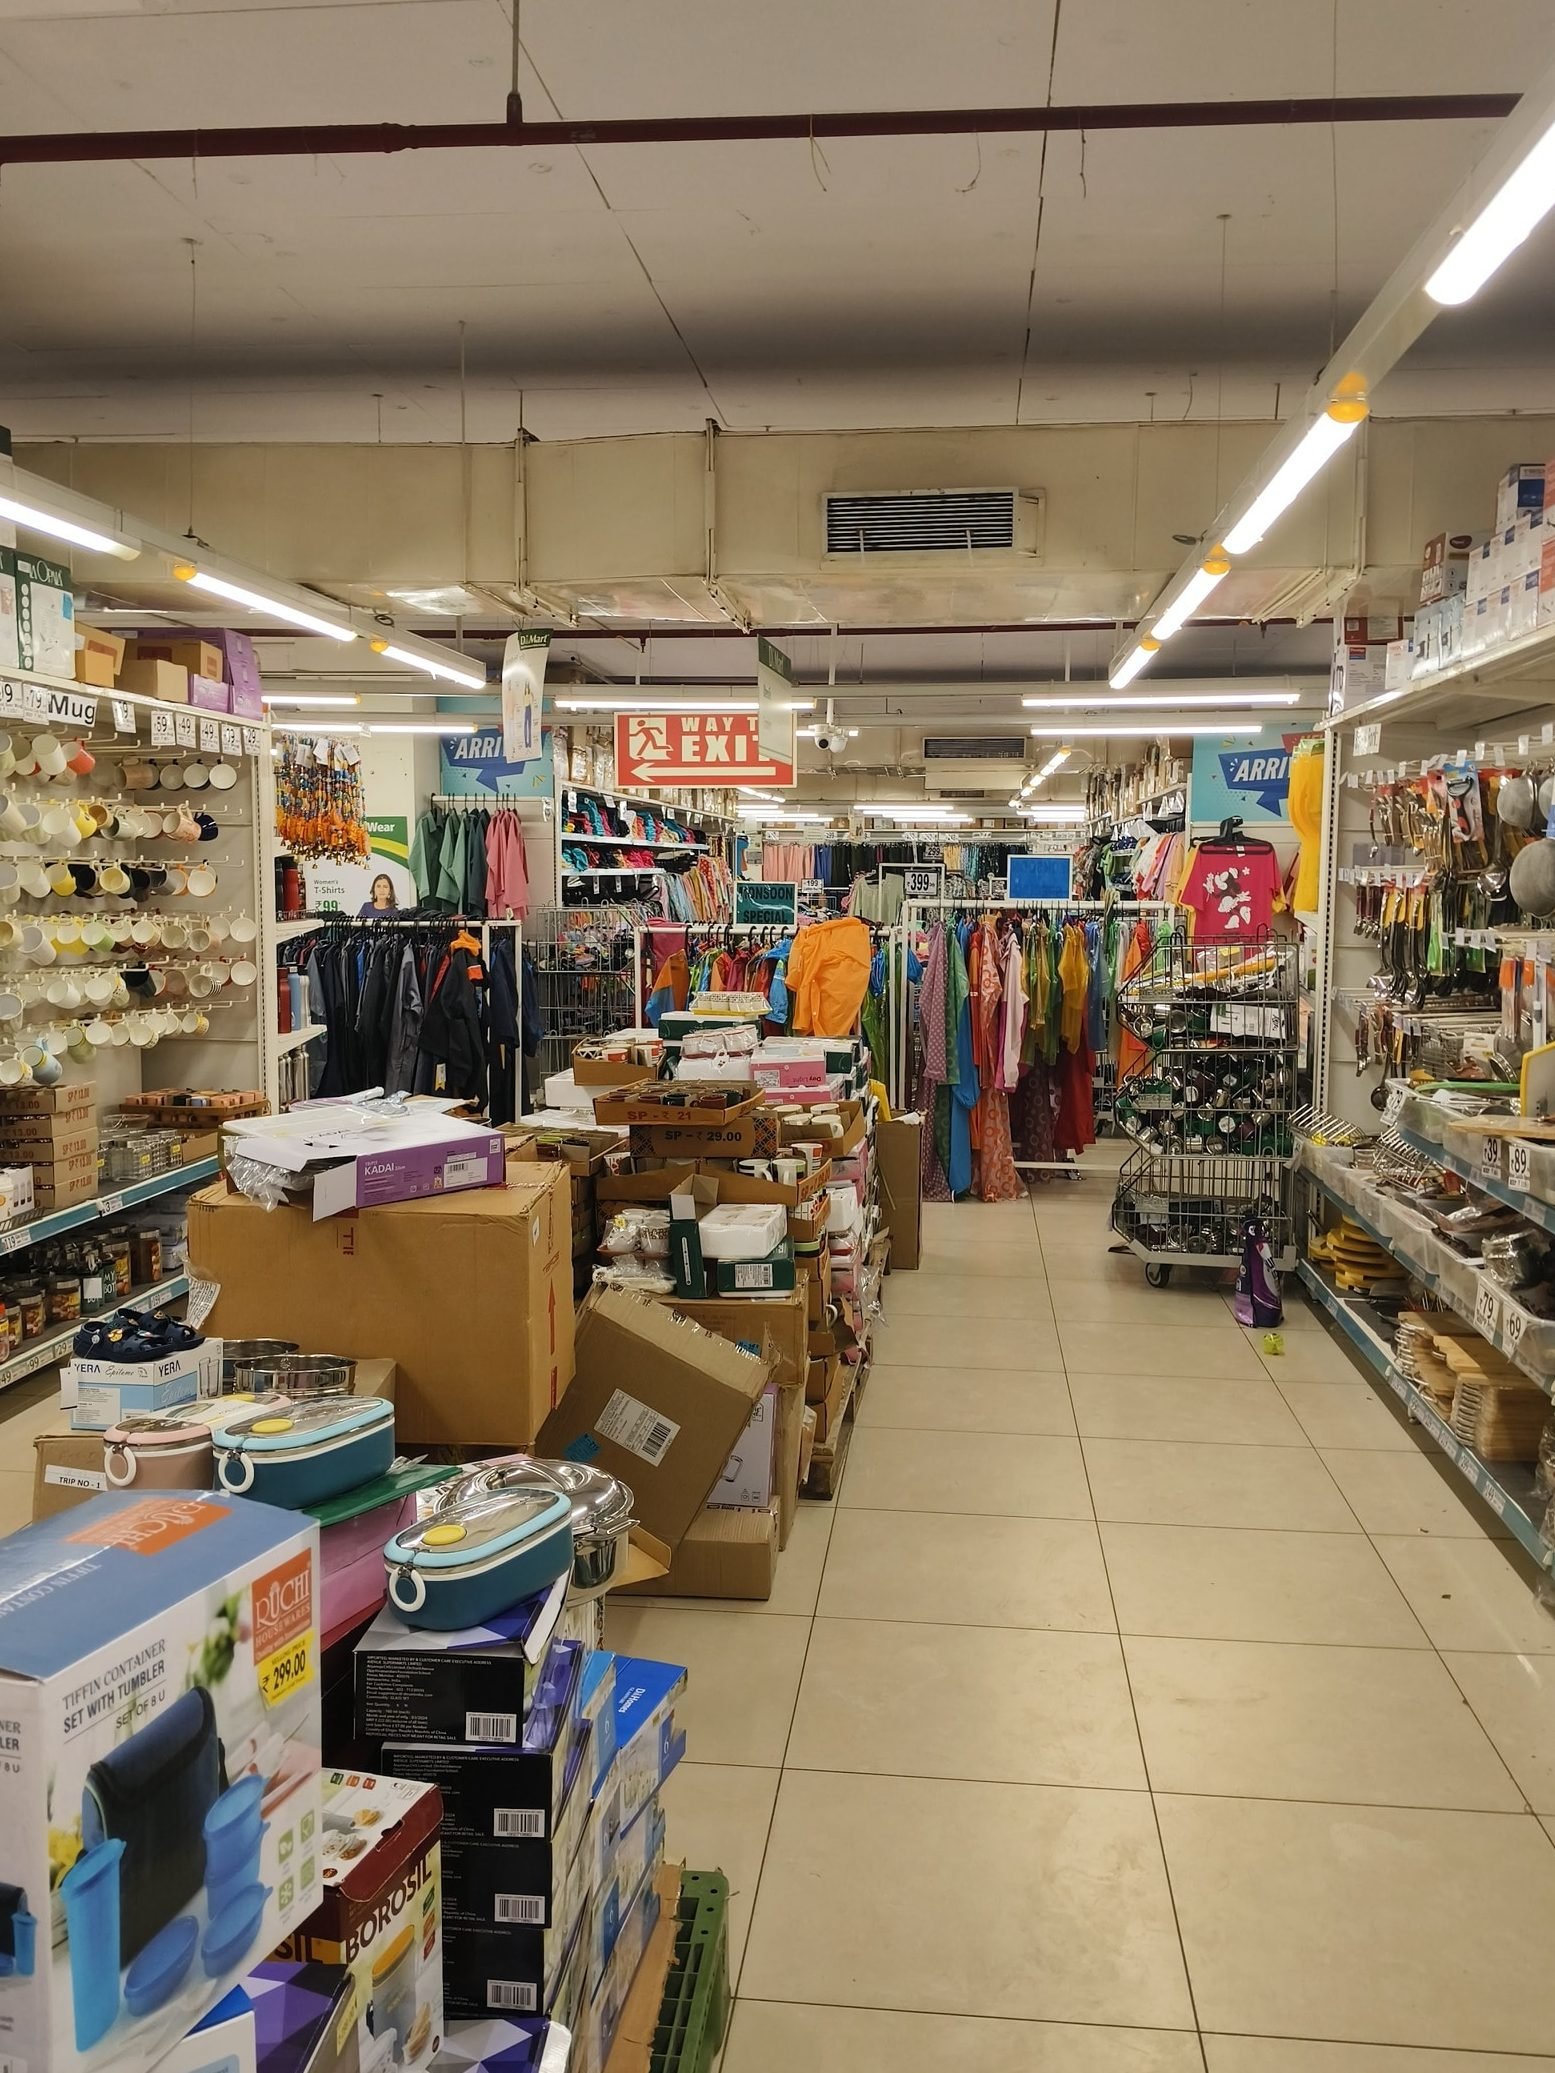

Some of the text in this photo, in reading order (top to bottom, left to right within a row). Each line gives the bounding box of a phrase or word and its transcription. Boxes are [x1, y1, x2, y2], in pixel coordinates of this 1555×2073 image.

[48, 694, 95, 725] Mug
[681, 717, 759, 732] WAY T
[454, 736, 502, 759] ARRI
[1233, 756, 1294, 782] ARRI
[367, 822, 395, 832] Wear
[314, 886, 345, 894] T-Shirts
[743, 910, 788, 922] SPECIAL
[627, 1110, 647, 1120] SP
[677, 1111, 691, 1120] 21
[665, 1130, 682, 1141] SP
[706, 1131, 742, 1142] 29.00
[364, 1162, 394, 1176] KADAI
[104, 1271, 116, 1281] MY
[74, 1364, 100, 1373] YERA
[159, 1360, 181, 1377] YERA
[59, 1476, 76, 1485] TRIP
[256, 1569, 310, 1628] RUCHI
[255, 1604, 311, 1649] HOUSEWARES
[62, 1639, 166, 1710] TIFFIN CONTAINER
[273, 1650, 306, 1690] 299.00
[64, 1659, 165, 1733] SET WITH TUMBLER
[116, 1689, 166, 1729] SET OF 8 U
[345, 1854, 432, 1964] BOROSIL
